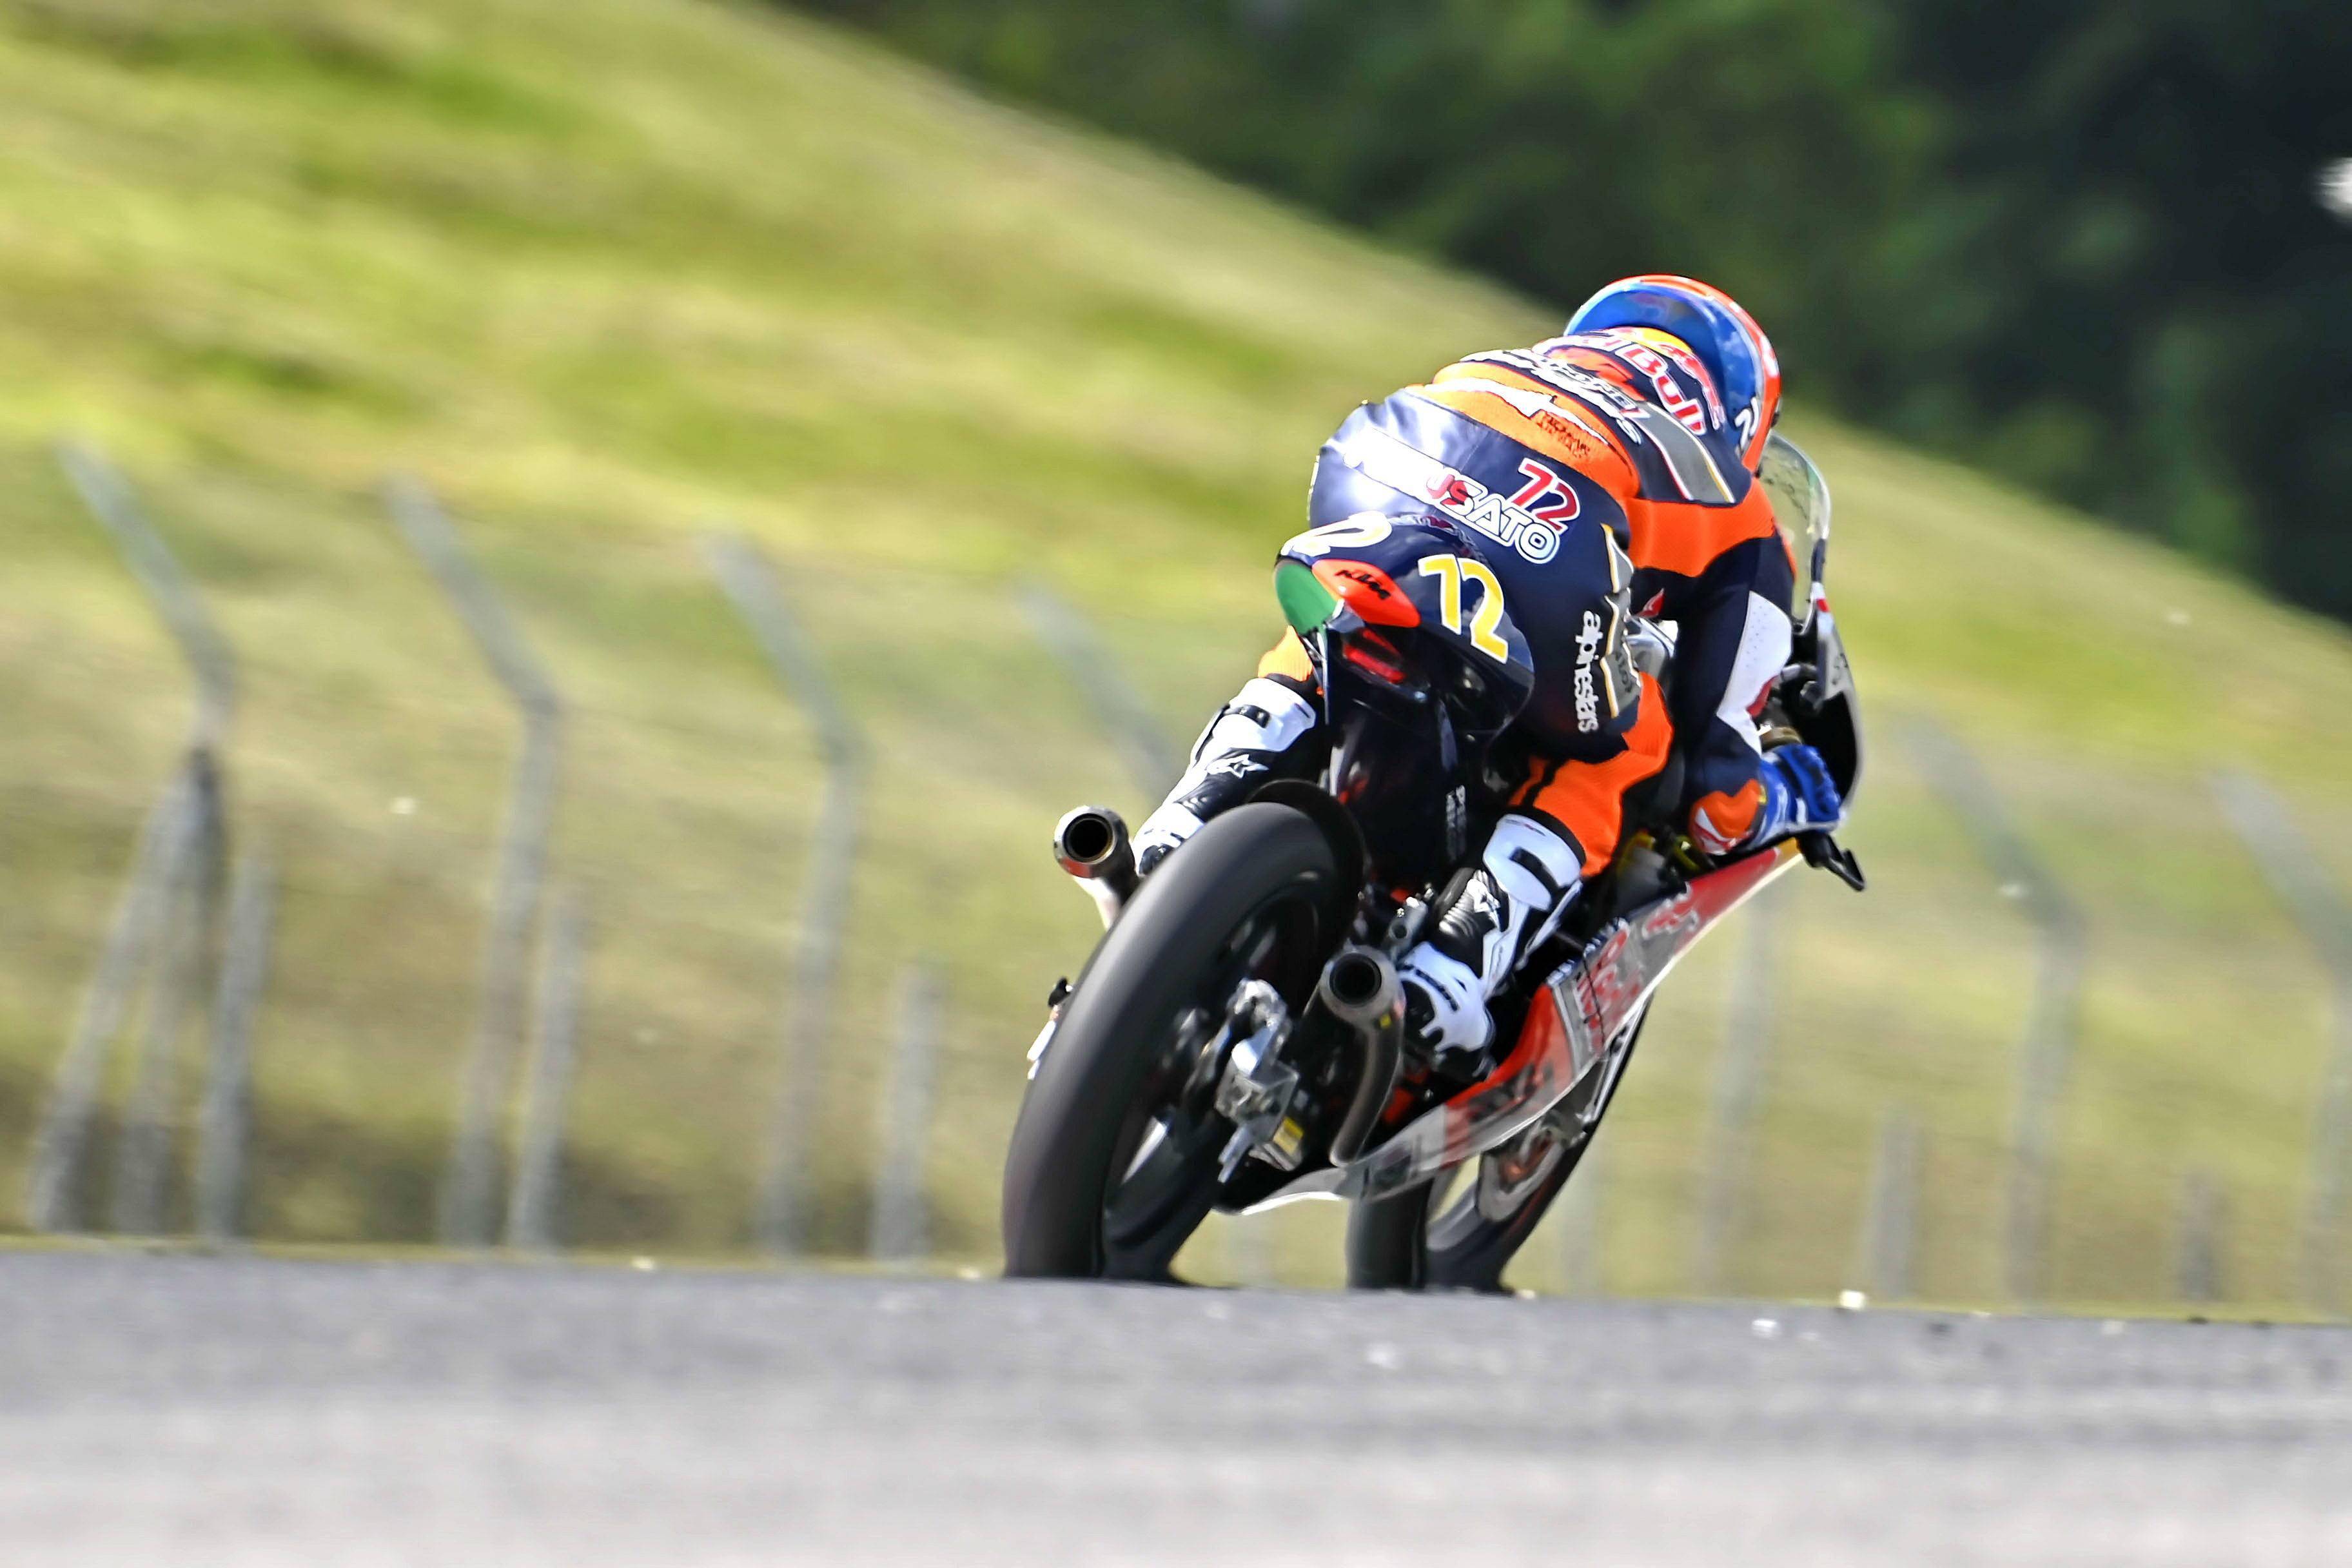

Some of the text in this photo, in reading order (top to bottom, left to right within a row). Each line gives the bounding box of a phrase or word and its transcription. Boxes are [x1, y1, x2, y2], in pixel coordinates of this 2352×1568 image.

[1518, 457, 1581, 536] 72
[1418, 554, 1509, 664] 72
[1574, 610, 1604, 733] alpinestars
